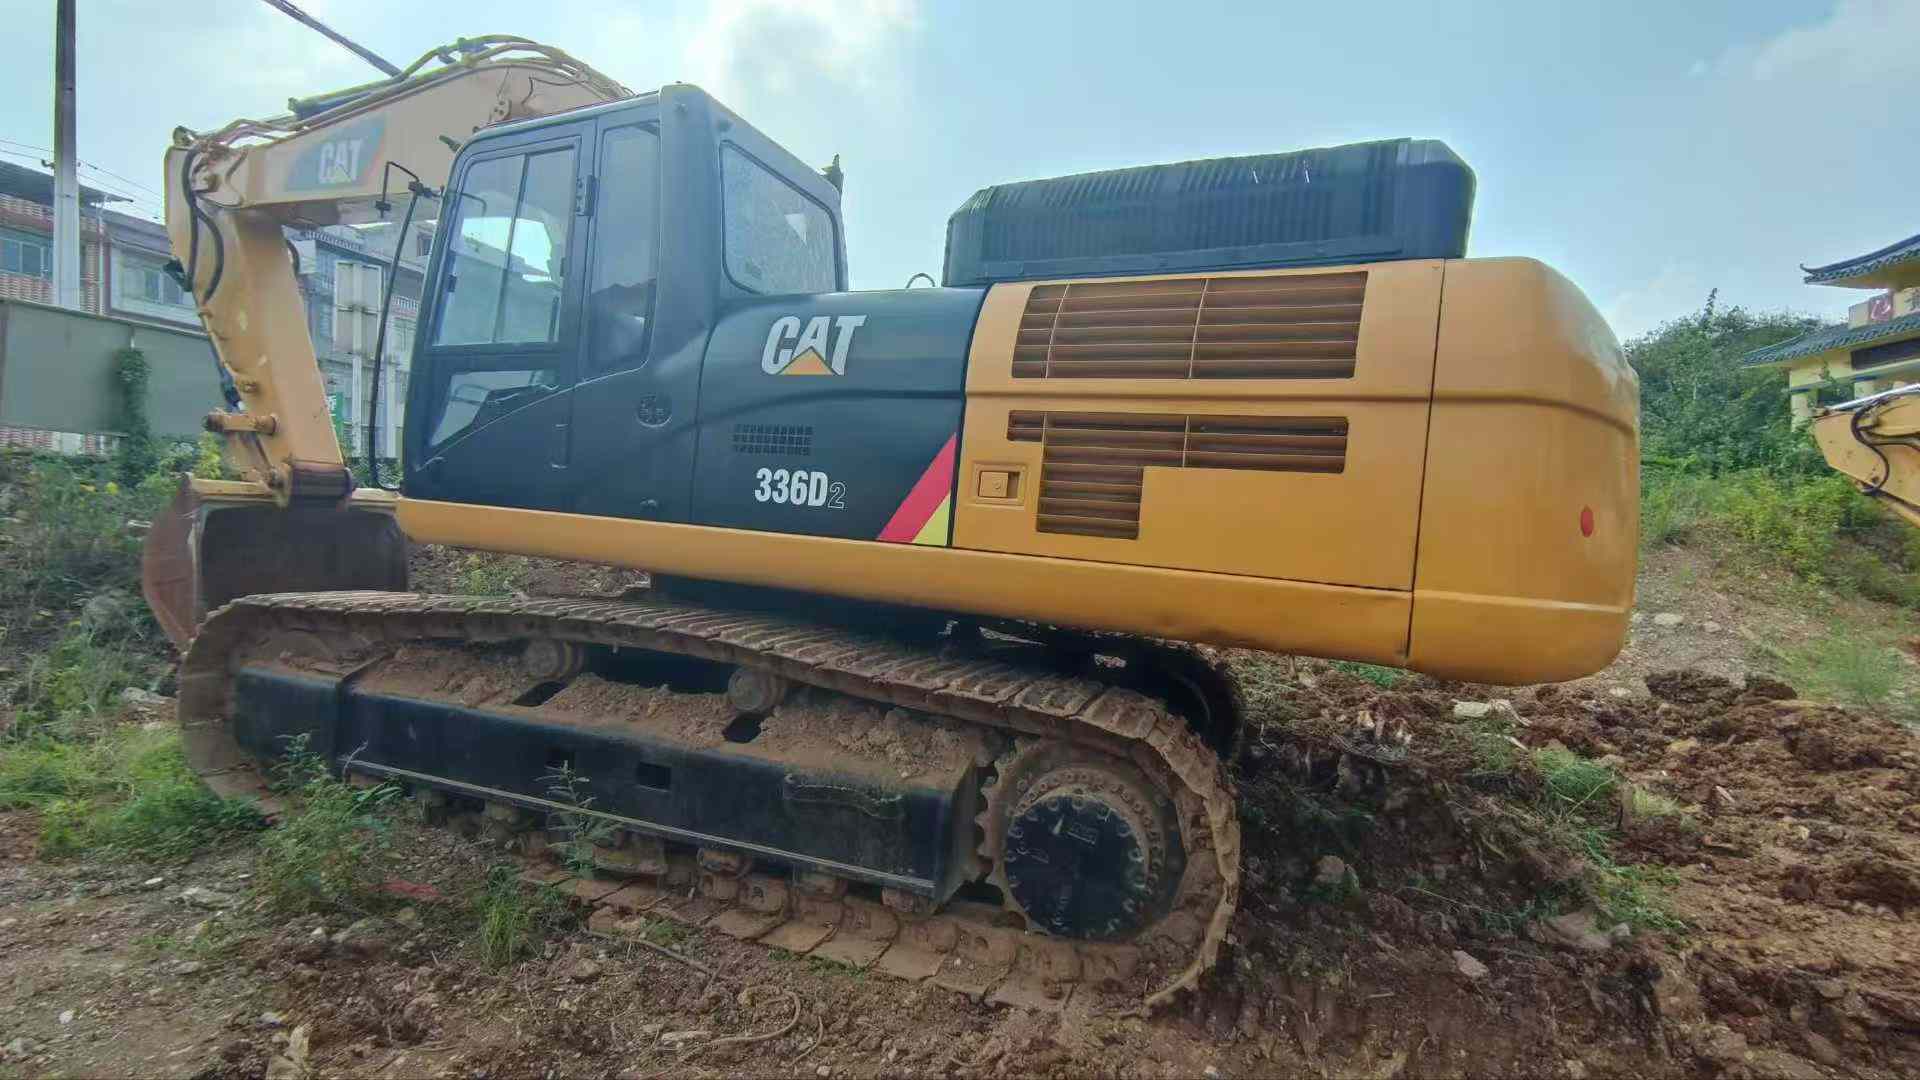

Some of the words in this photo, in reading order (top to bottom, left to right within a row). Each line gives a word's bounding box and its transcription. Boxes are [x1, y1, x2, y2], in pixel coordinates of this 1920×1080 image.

[319, 138, 366, 183] CAT
[761, 315, 867, 375] CAT
[755, 467, 846, 509] 336D2
